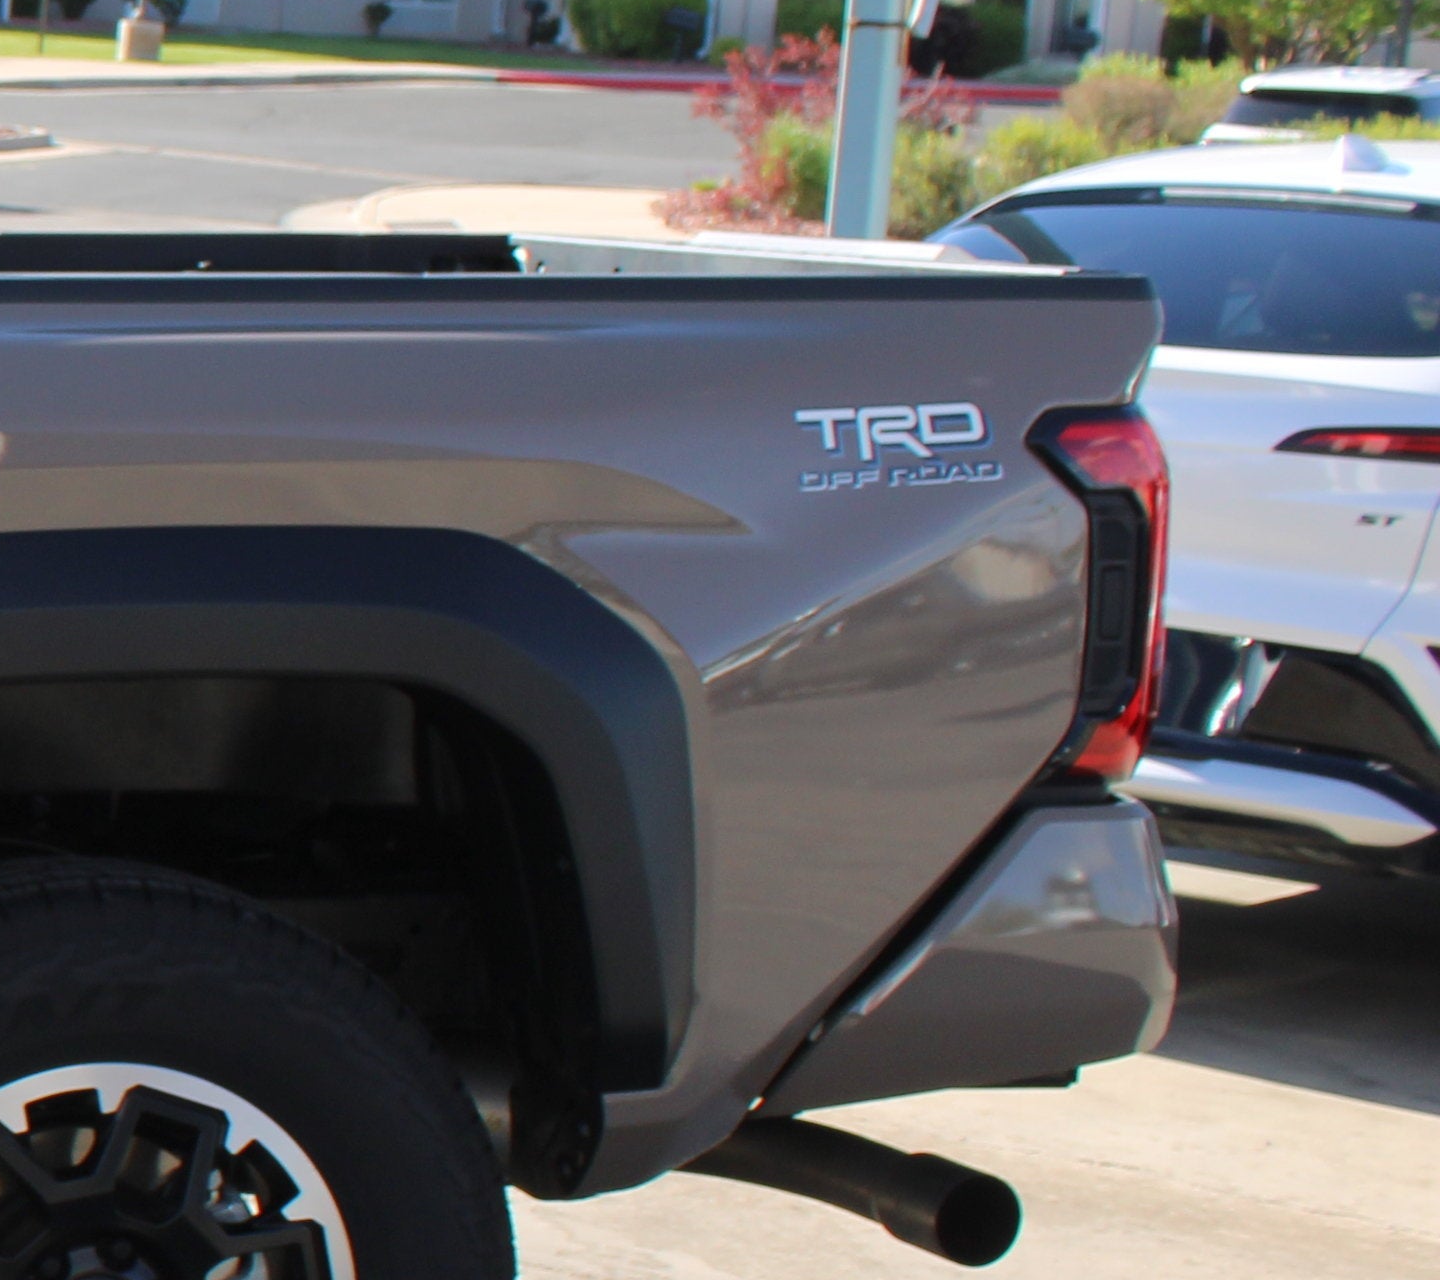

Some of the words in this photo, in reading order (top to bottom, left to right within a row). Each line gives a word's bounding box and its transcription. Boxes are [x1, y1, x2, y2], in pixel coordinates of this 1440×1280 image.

[794, 402, 986, 462] TRD
[799, 470, 881, 493] OFF
[888, 461, 1005, 488] ROAD
